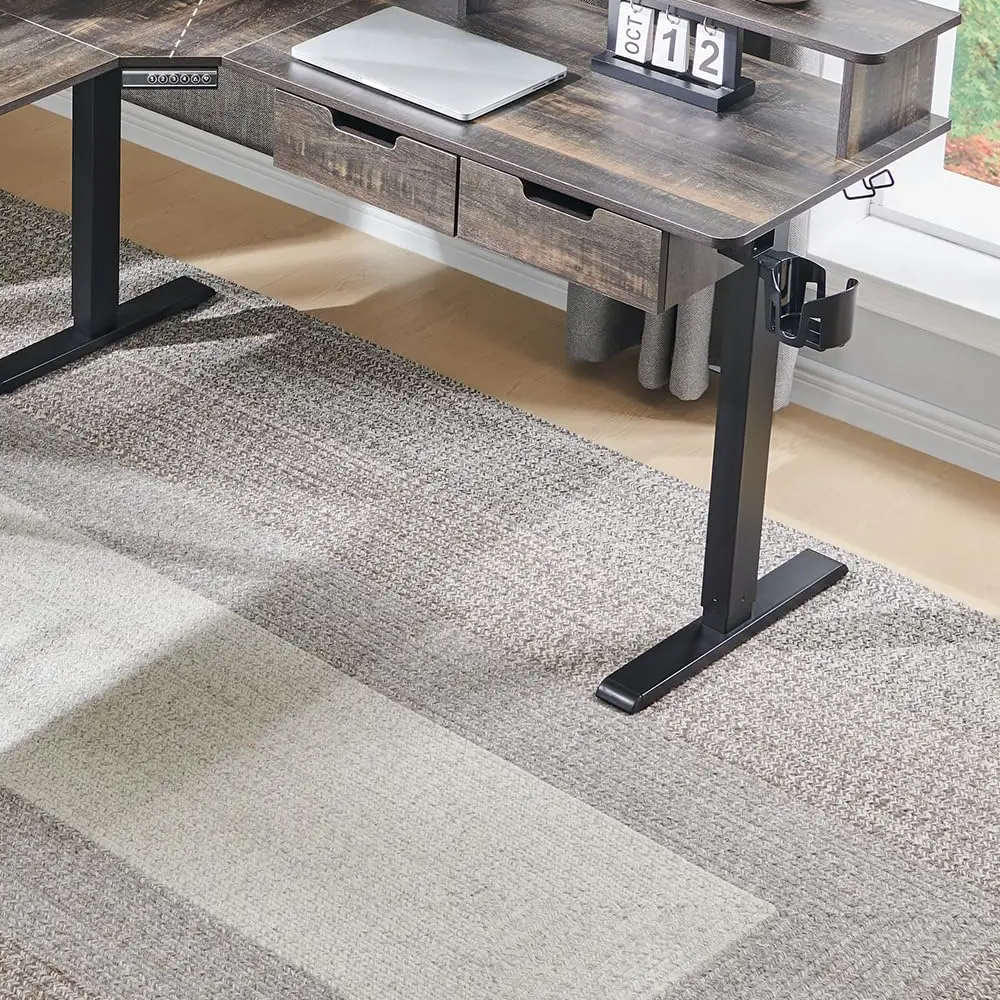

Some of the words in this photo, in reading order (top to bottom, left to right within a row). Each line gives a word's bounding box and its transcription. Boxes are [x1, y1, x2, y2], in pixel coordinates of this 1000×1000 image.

[624, 15, 644, 55] OCT
[662, 28, 678, 62] 1
[698, 40, 720, 76] 2
